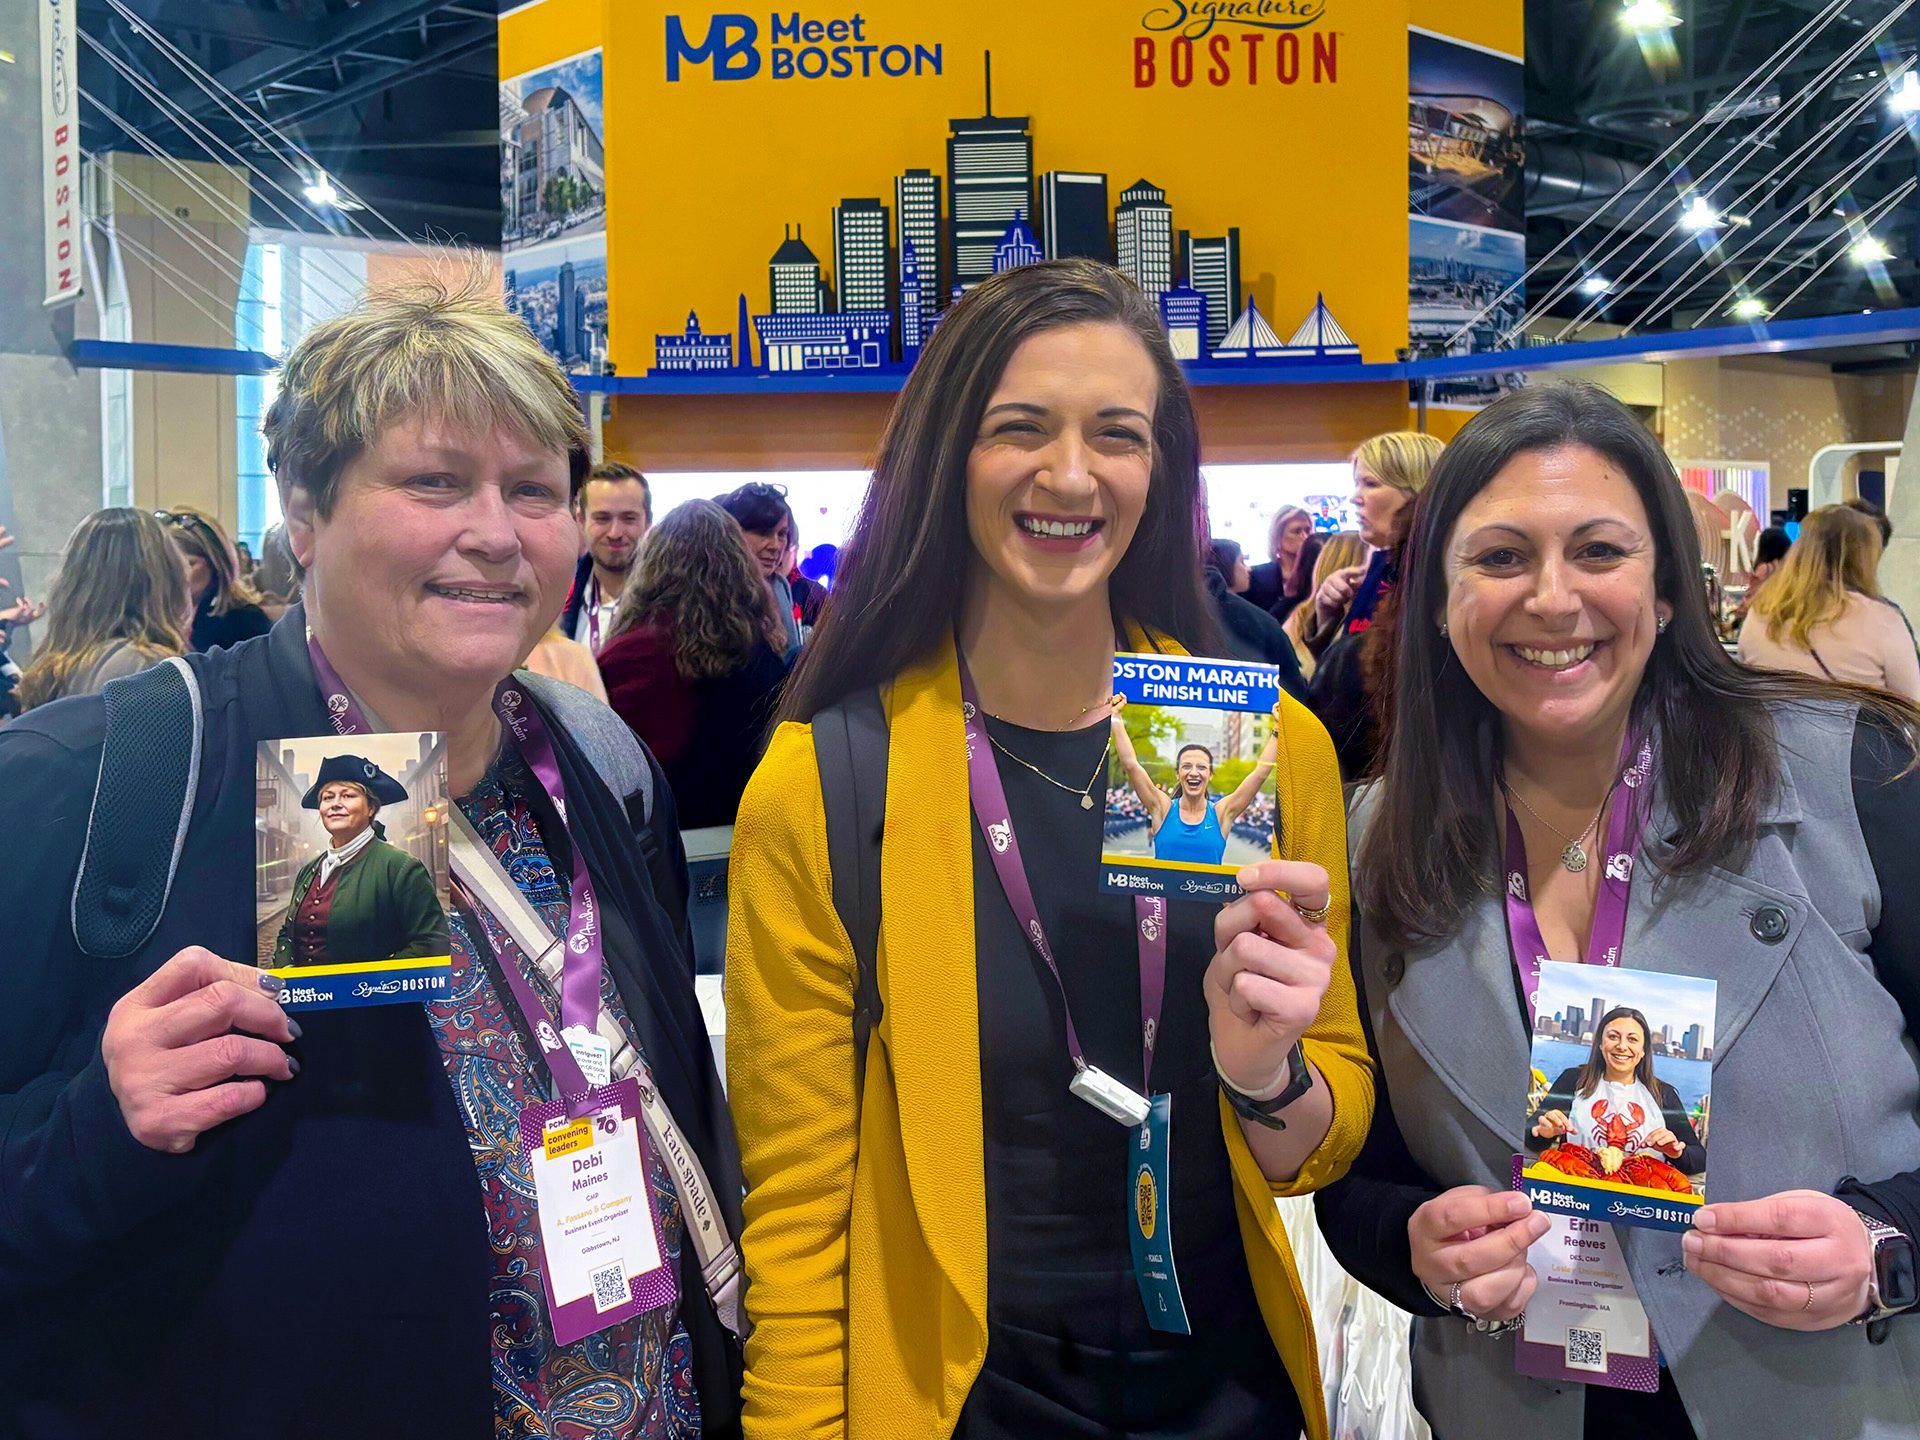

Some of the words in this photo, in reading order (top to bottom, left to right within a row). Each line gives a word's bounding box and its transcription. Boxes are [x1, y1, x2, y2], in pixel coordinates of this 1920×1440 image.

[771, 12, 865, 44] Meet
[771, 44, 943, 79] BOSTON
[1134, 32, 1337, 88] BOSTON
[55, 124, 71, 291] BOSTON
[1113, 662, 1181, 682] OSTON
[1143, 683, 1202, 701] FINISH
[1208, 687, 1249, 705] LINE
[500, 705, 528, 742] Anaheim
[1129, 874, 1149, 883] Meet
[1129, 881, 1164, 891] BOSTON
[1225, 885, 1244, 895] BOS
[579, 889, 597, 937] Anaheim
[1145, 896, 1163, 926] Anah
[402, 976, 447, 992] BOSTON
[276, 989, 291, 1004] B
[292, 986, 316, 996] Meet
[292, 992, 333, 1004] BOSTON
[548, 1119, 569, 1130] PCMA
[548, 1126, 589, 1144] convening
[549, 1140, 578, 1154] leaders
[572, 1151, 603, 1173] Debi
[662, 1124, 685, 1168] kate
[682, 1168, 707, 1218] spade
[572, 1172, 608, 1191] Maines
[586, 1192, 599, 1201] CMP
[600, 1195, 632, 1211] Company
[1553, 1192, 1574, 1202] Meet
[1553, 1199, 1590, 1212] BOSTON
[1655, 1209, 1696, 1225] BOSTO
[564, 1224, 588, 1236] Business
[588, 1217, 603, 1228] Event
[1569, 1218, 1599, 1233] Erin
[612, 1235, 621, 1243] NJ
[1564, 1235, 1606, 1250] Reeves
[1547, 1275, 1573, 1284] Business
[1575, 1278, 1592, 1287] Event
[1593, 1281, 1624, 1290] Organizer
[1559, 1299, 1598, 1311] Framingham,
[1600, 1304, 1611, 1312] MA
